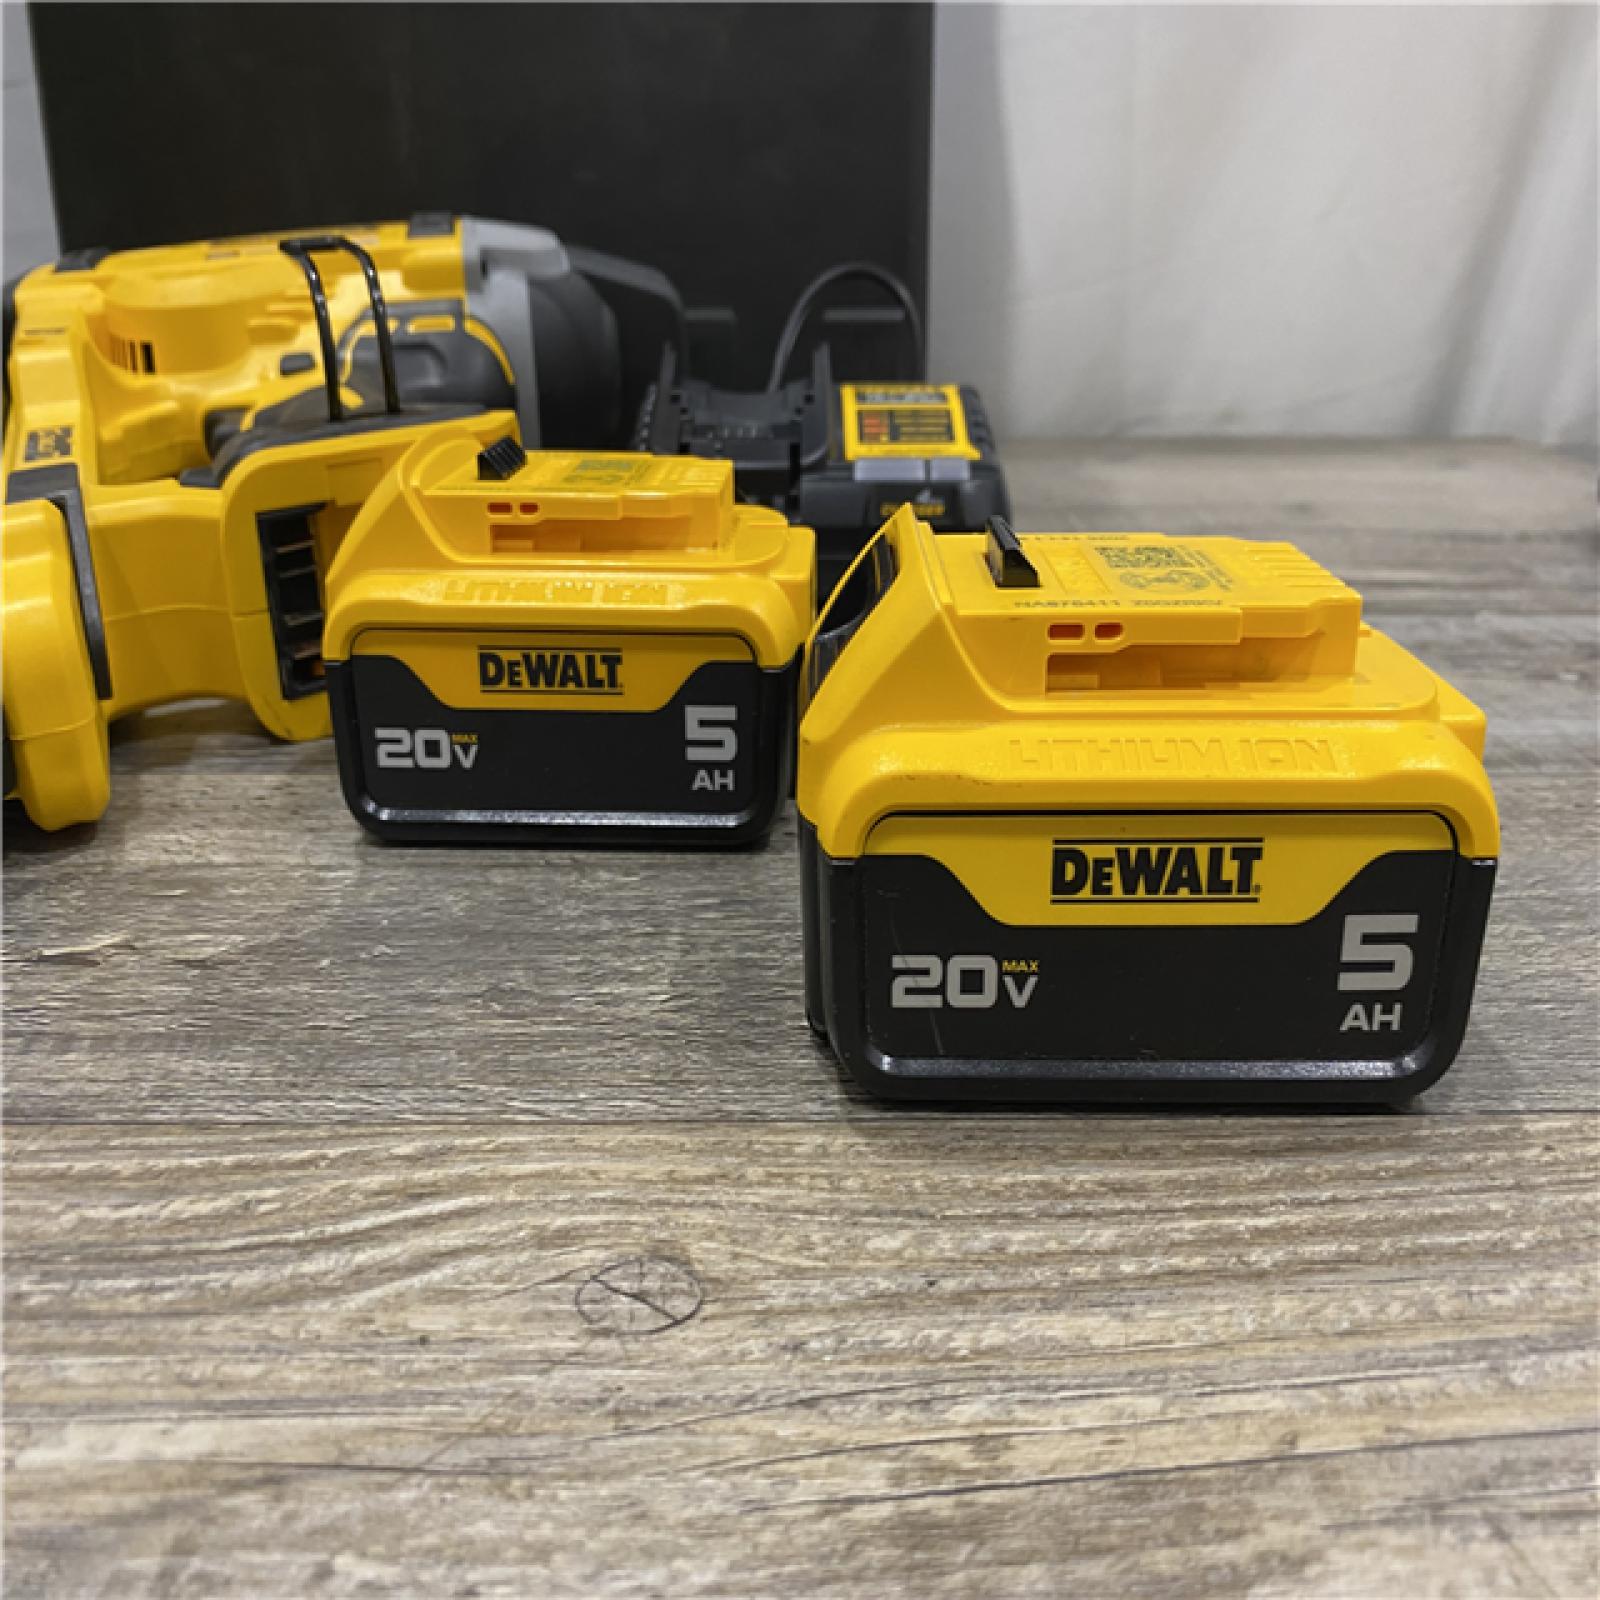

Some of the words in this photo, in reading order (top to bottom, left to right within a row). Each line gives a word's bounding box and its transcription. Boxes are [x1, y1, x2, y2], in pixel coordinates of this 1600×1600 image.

[684, 704, 738, 762] 5
[1009, 739, 1229, 772] LITHIUM
[1238, 739, 1337, 772] ION
[691, 769, 735, 791] AH
[1002, 959, 1040, 974] MAX
[1337, 914, 1419, 991] 5
[1339, 1003, 1401, 1031] AH
